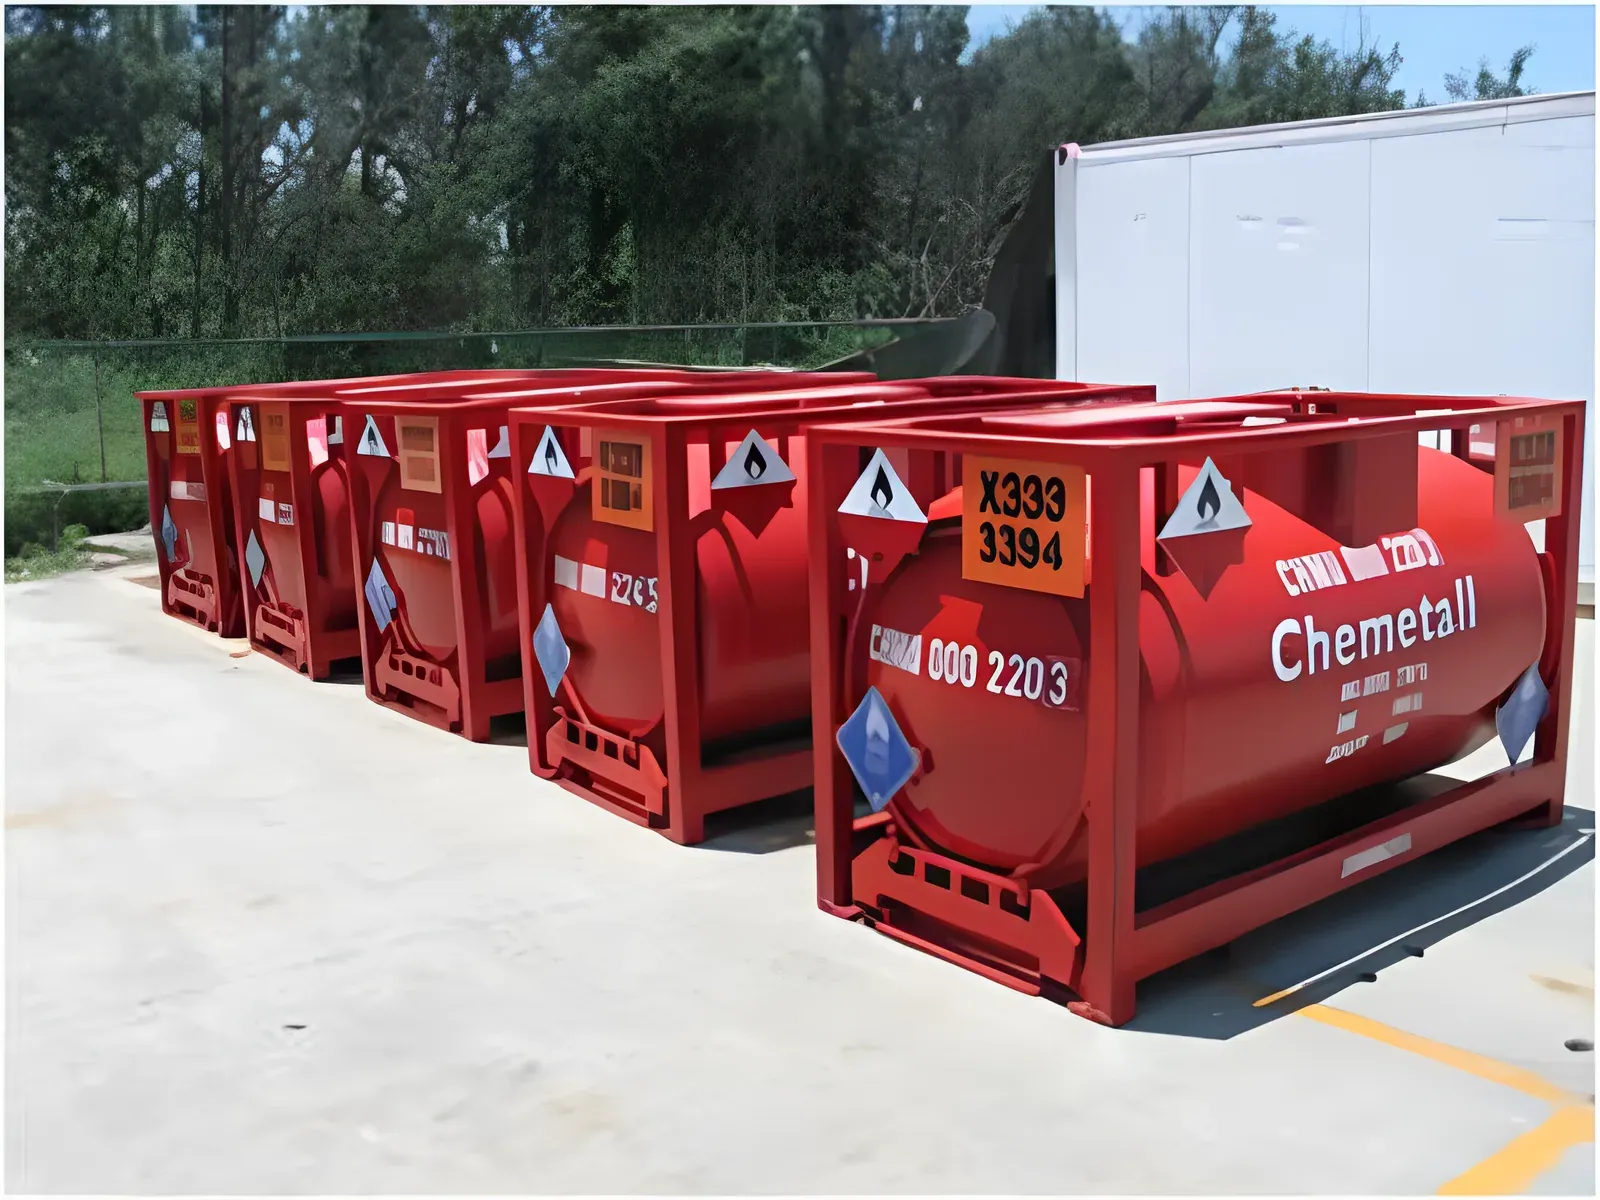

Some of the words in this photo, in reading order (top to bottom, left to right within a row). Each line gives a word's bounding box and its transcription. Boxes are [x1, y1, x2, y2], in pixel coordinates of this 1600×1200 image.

[979, 469, 1066, 522] X333
[979, 521, 1063, 571] 3394
[1271, 574, 1476, 682] Chemetall
[927, 637, 978, 688] 000
[986, 649, 1068, 705] 2203
